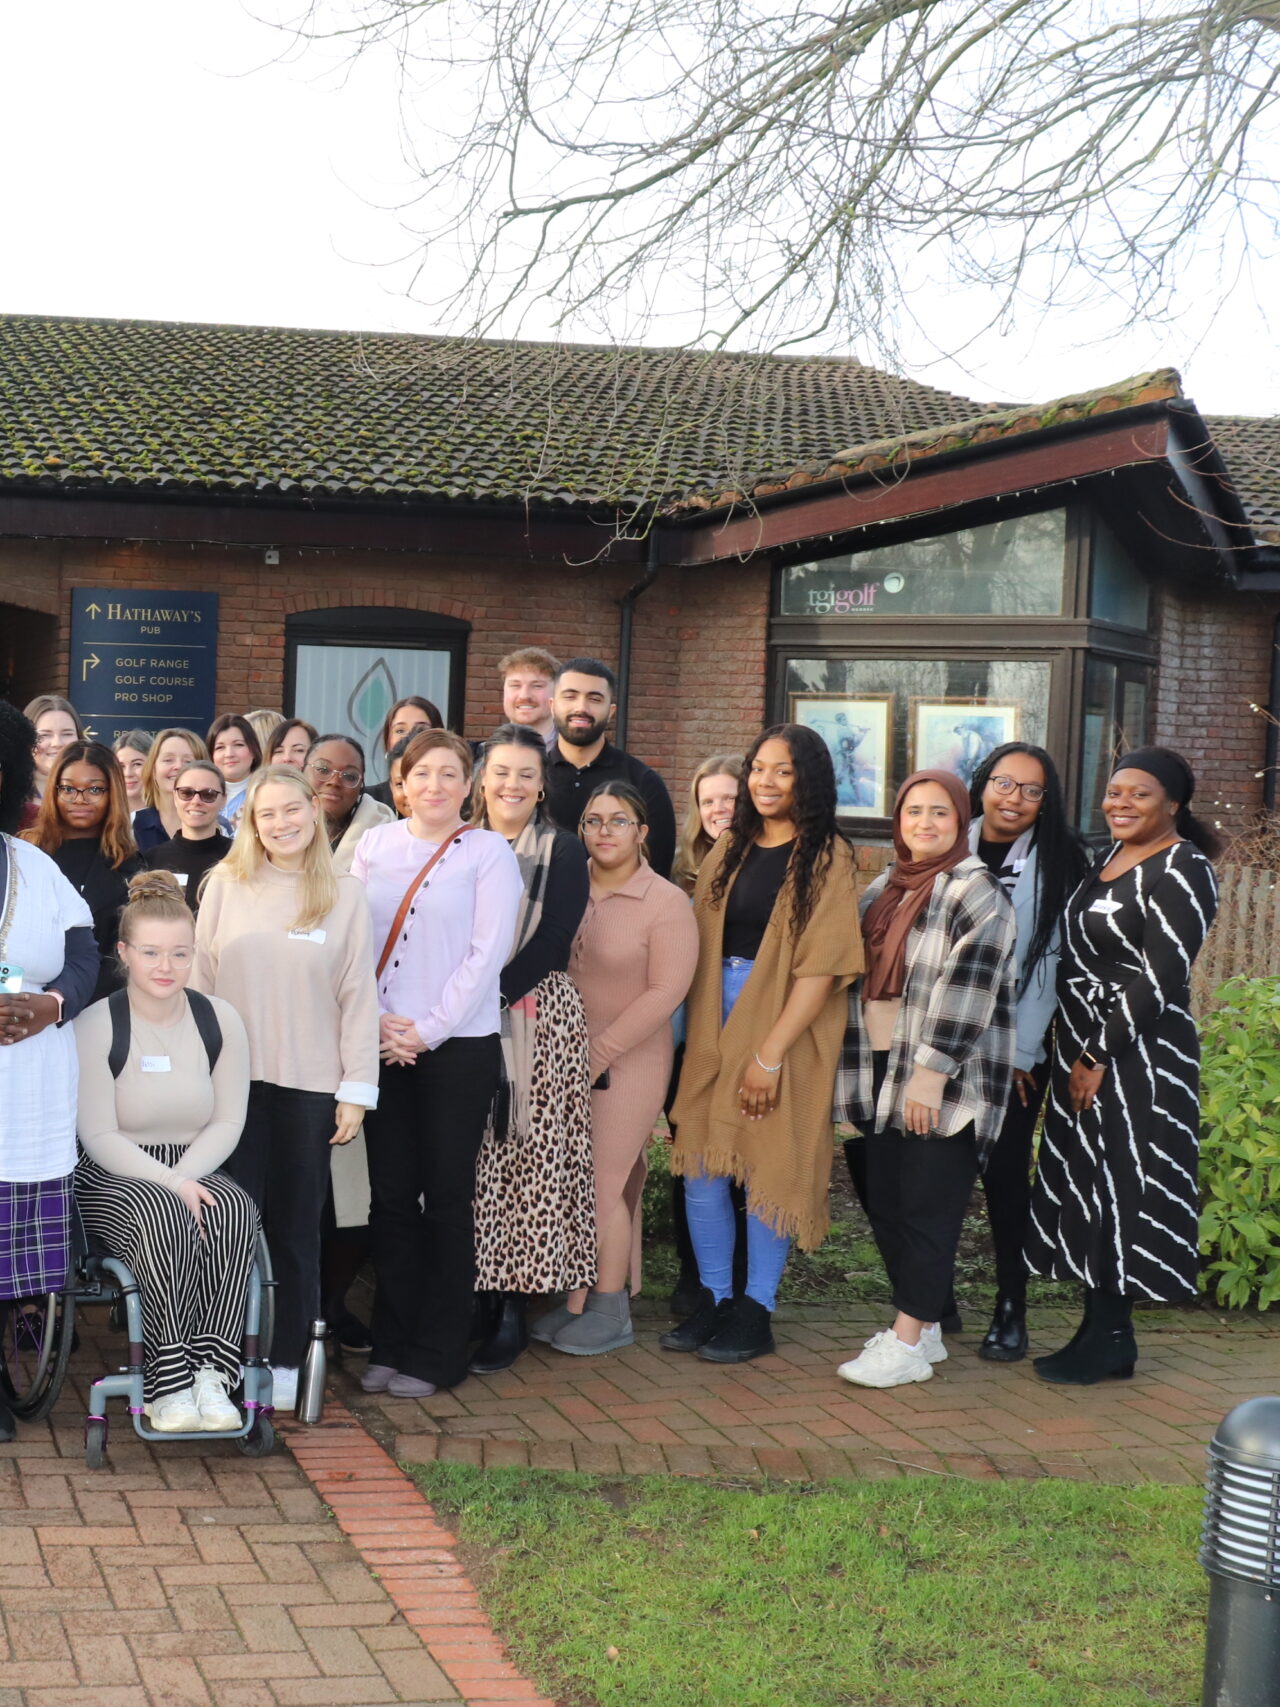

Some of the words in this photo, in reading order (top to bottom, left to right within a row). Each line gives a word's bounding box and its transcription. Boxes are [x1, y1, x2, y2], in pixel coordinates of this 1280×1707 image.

[107, 603, 202, 623] HATHAWAY'S
[140, 626, 161, 634] PUB
[115, 658, 147, 667] GOLF
[150, 658, 190, 669] RANGE
[115, 675, 146, 685] GOLF
[149, 677, 195, 687] COURSE
[114, 692, 138, 701] PRO
[142, 693, 173, 703] SHOP
